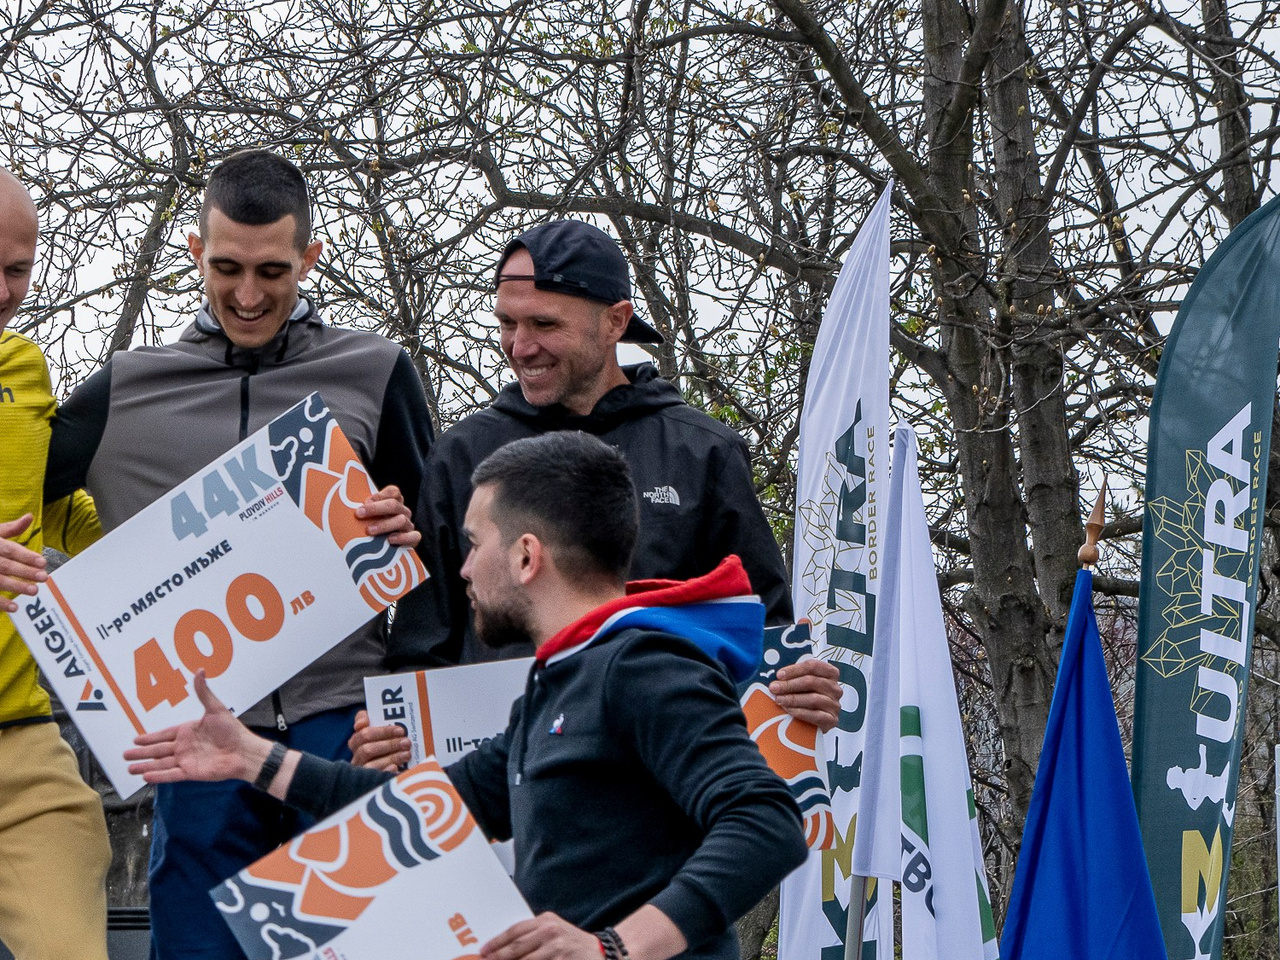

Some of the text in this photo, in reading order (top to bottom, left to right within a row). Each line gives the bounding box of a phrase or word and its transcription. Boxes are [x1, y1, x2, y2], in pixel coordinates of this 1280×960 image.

[170, 443, 279, 541] 44K
[239, 486, 284, 521] PLOVDIV HILLS
[867, 425, 878, 581] BORDER RACE
[1247, 430, 1262, 588] BORDER RACE
[130, 573, 184, 616] МЯСТО
[183, 539, 233, 579] МЪЖЕ
[1196, 401, 1252, 743] ULTRA
[25, 597, 85, 678] AIGER
[133, 572, 285, 712] 400
